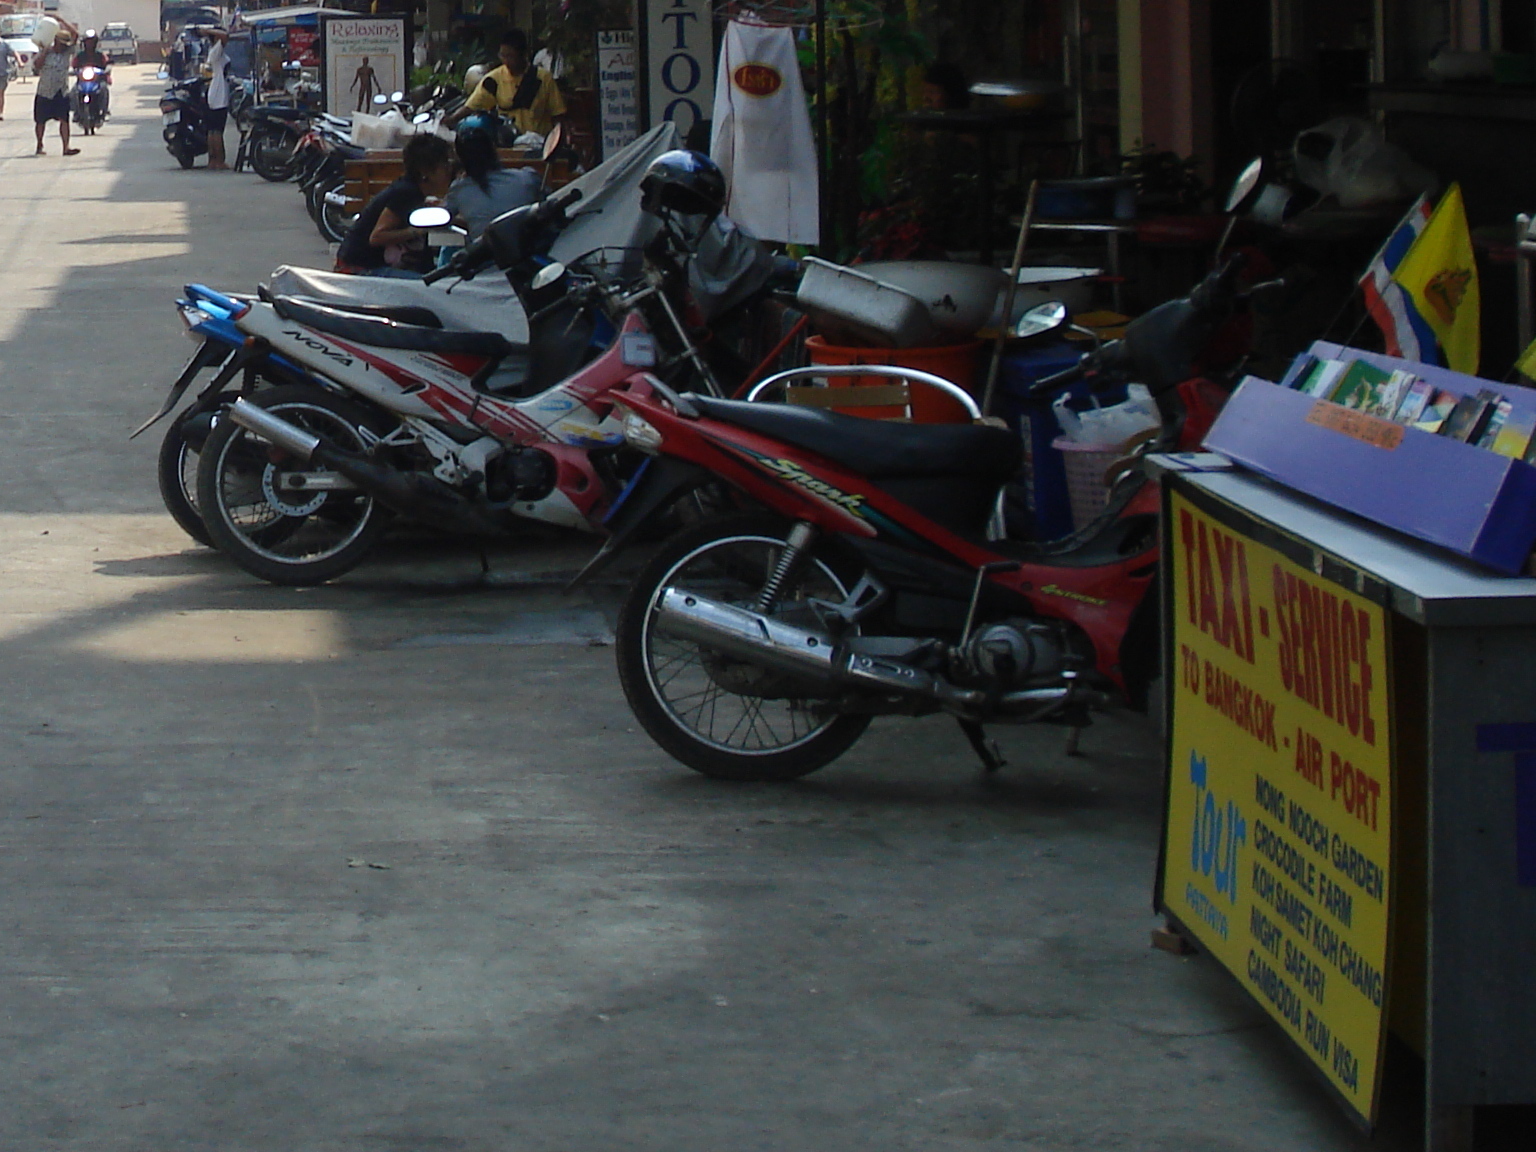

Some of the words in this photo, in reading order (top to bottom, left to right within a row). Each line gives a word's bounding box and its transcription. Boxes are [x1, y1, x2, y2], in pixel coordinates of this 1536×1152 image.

[281, 330, 354, 368] NOVA
[1181, 644, 1201, 696] TO
[1204, 659, 1278, 754] BANGKOK
[1296, 727, 1323, 793] AIR
[1331, 750, 1381, 833] PORT
[1190, 748, 1246, 906] Tour
[1254, 819, 1315, 898] CROCODILE
[1319, 872, 1353, 929] FARM
[1255, 773, 1286, 824] NONG
[1289, 799, 1330, 860] NOOCH
[1331, 834, 1384, 905] GARDEN
[1250, 905, 1282, 961] NIGHT
[1285, 938, 1325, 1005] SAFARI
[1252, 861, 1275, 908] KOH
[1275, 887, 1313, 941] SAMET
[1313, 917, 1340, 969] KOH
[1340, 939, 1384, 1008] CHANG
[1248, 948, 1302, 1033] CAMBODIA
[1305, 1009, 1331, 1061] RUN
[1334, 1043, 1358, 1094] VISA
